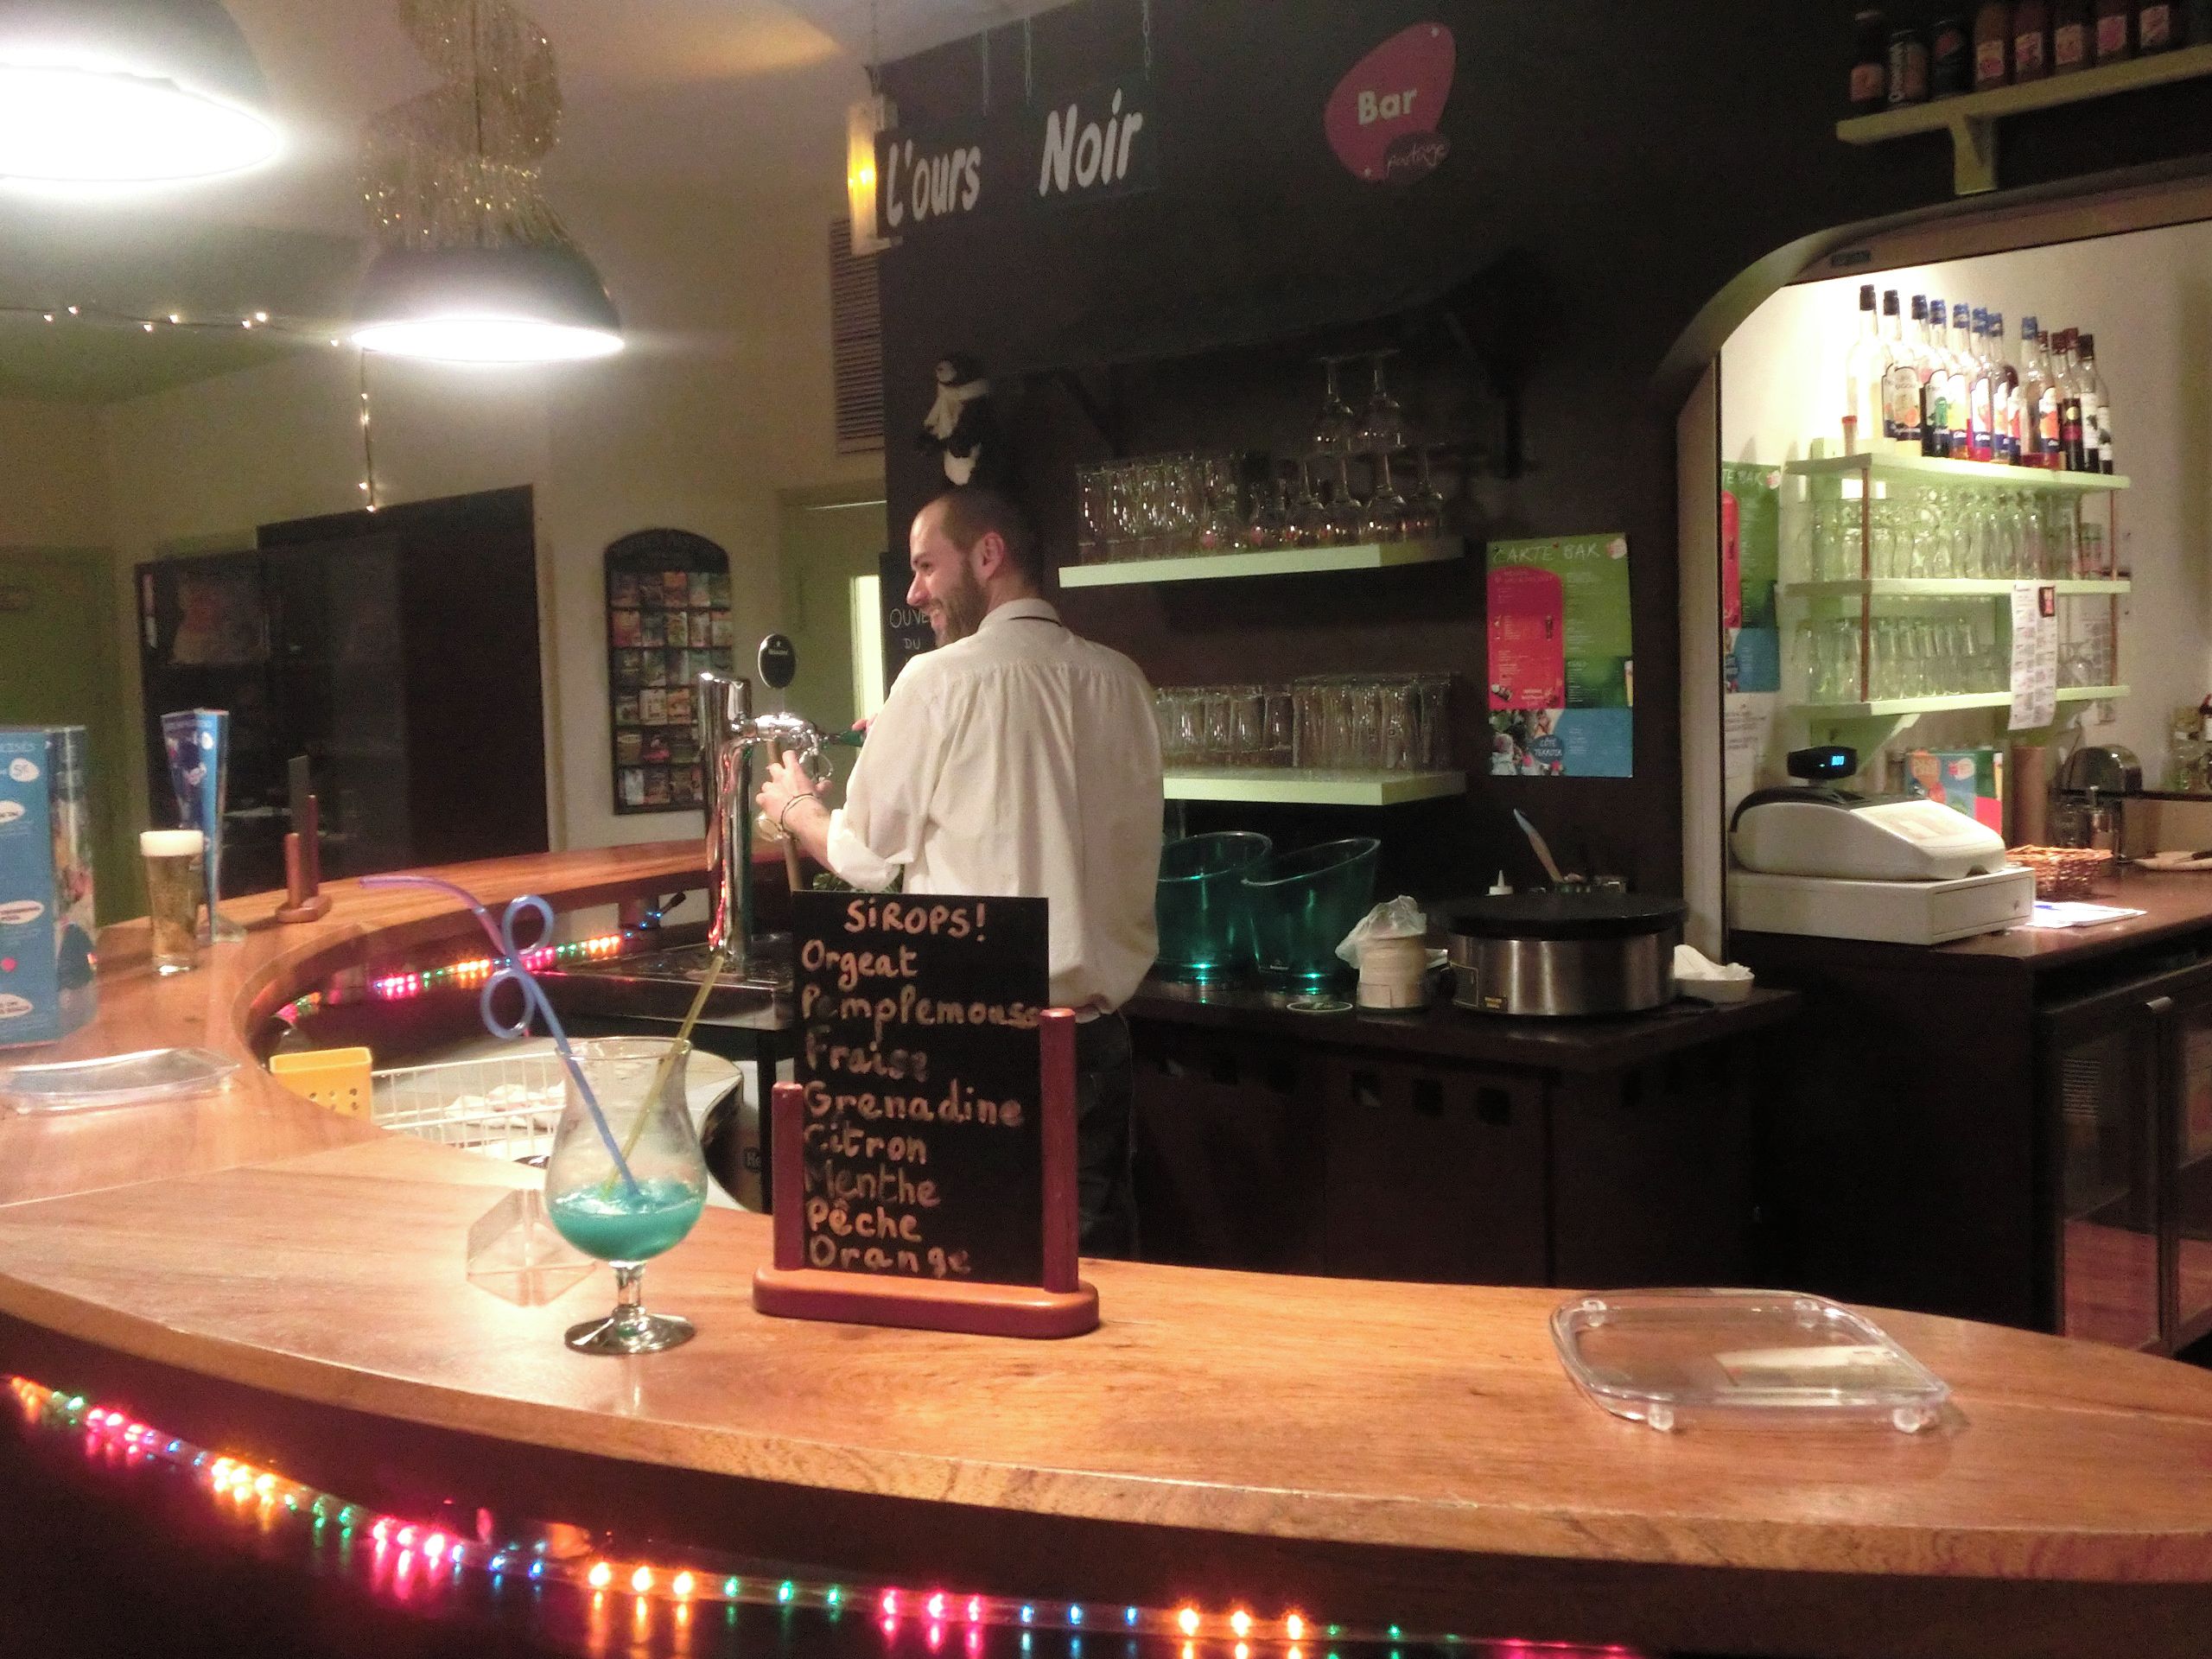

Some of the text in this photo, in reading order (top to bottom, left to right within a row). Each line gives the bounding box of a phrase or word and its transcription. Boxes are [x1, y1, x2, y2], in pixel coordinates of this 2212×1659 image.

[1357, 88, 1418, 125] Bar
[887, 87, 1144, 227] L'ours Noir
[889, 607, 931, 628] OUVE
[904, 637, 921, 650] DU
[801, 938, 918, 992] Orgeat
[804, 1079, 1025, 1127] Grenadine
[809, 1225, 972, 1279] Orange
